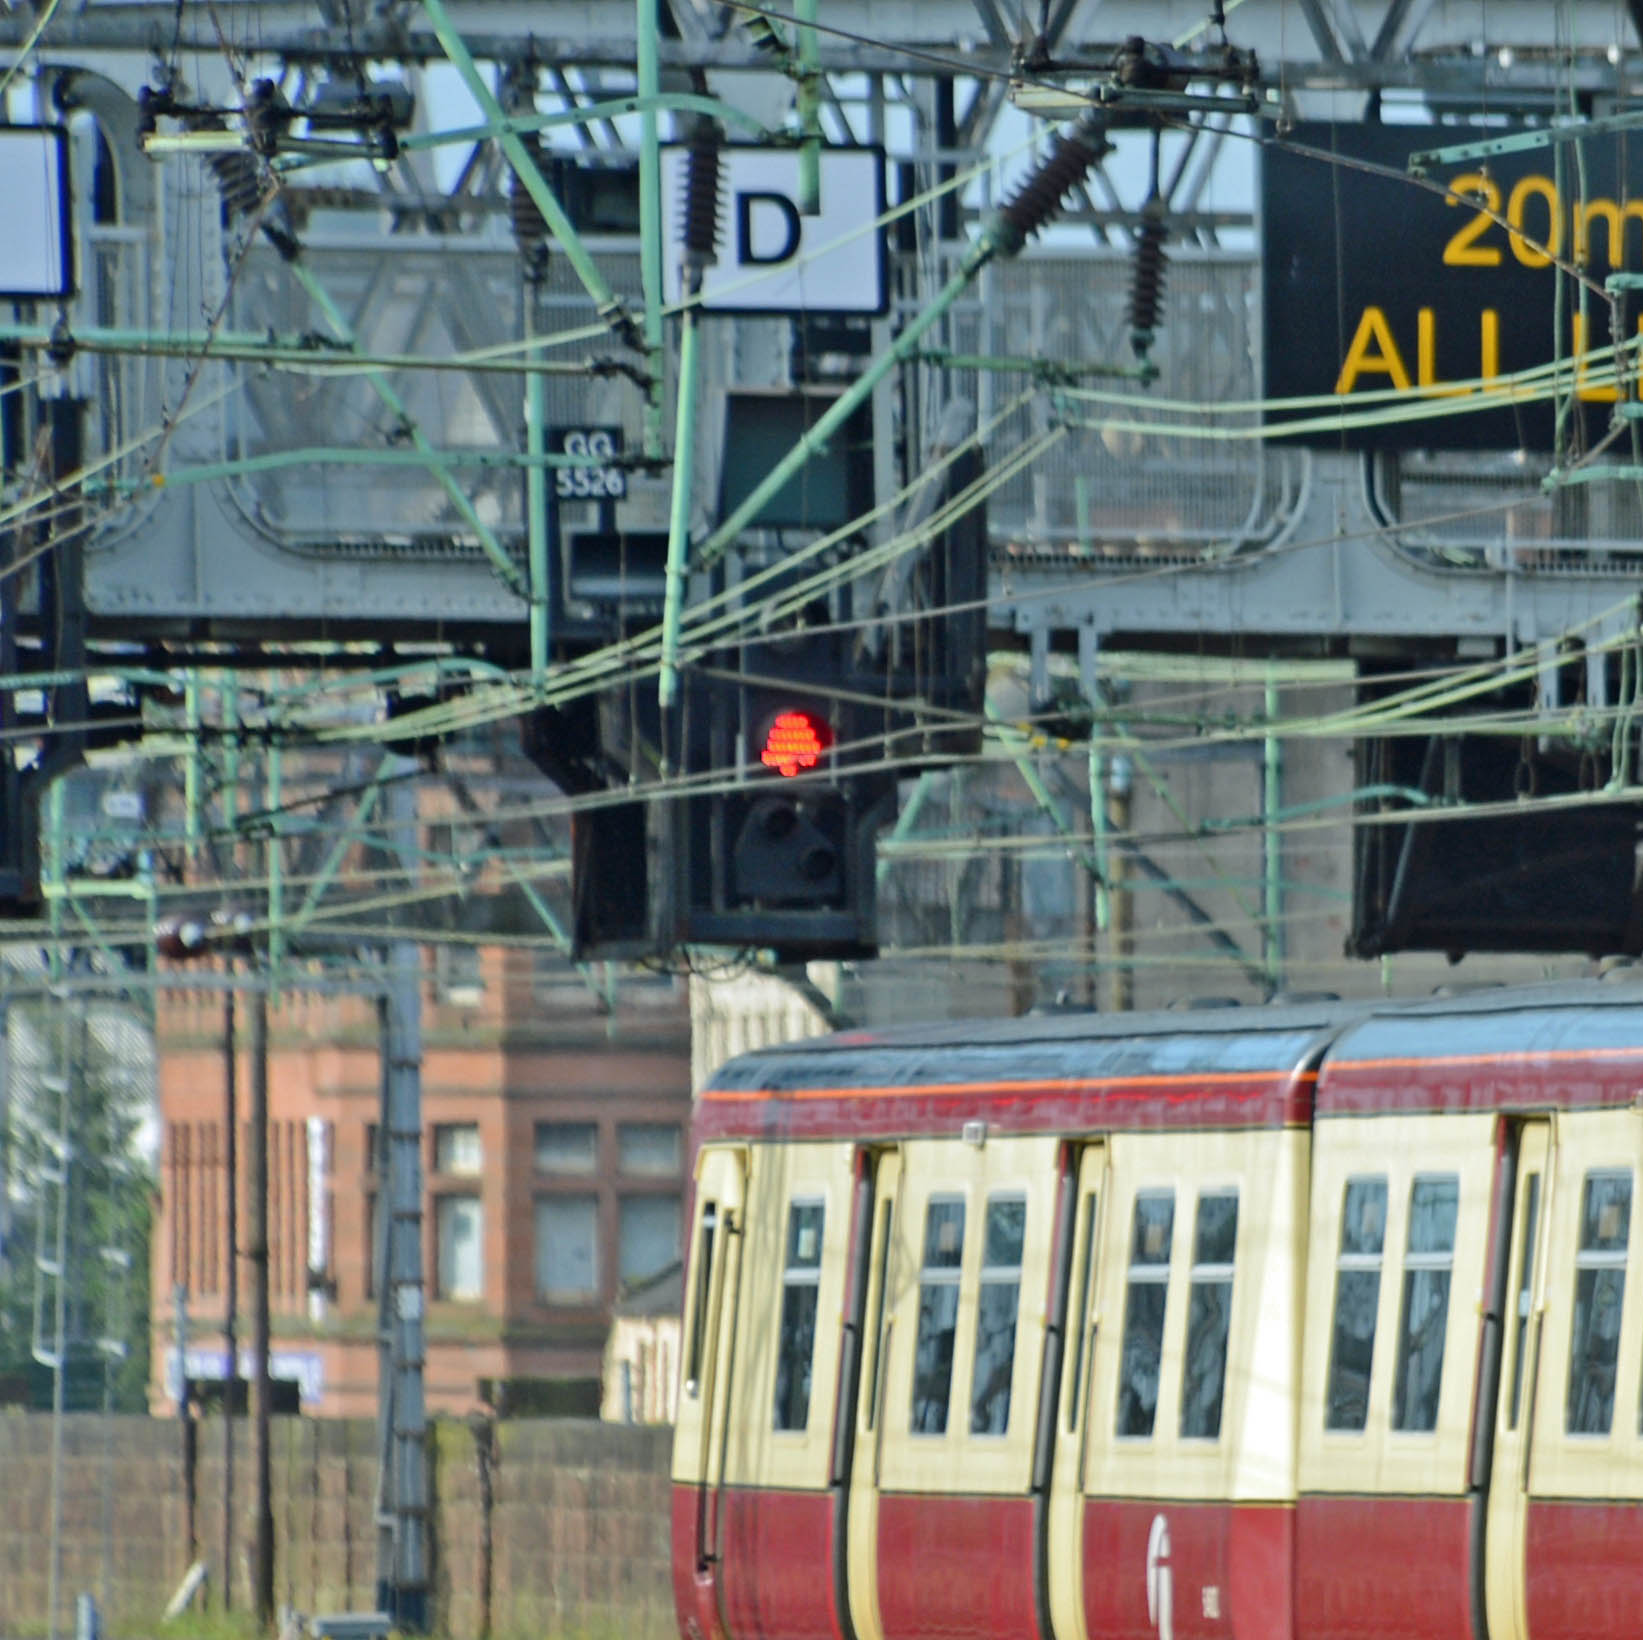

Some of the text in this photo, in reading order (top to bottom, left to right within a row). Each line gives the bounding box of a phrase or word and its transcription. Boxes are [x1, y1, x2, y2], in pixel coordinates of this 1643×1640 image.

[737, 191, 801, 265] D
[1335, 306, 1535, 398] ALL
[556, 466, 624, 496] 5526
